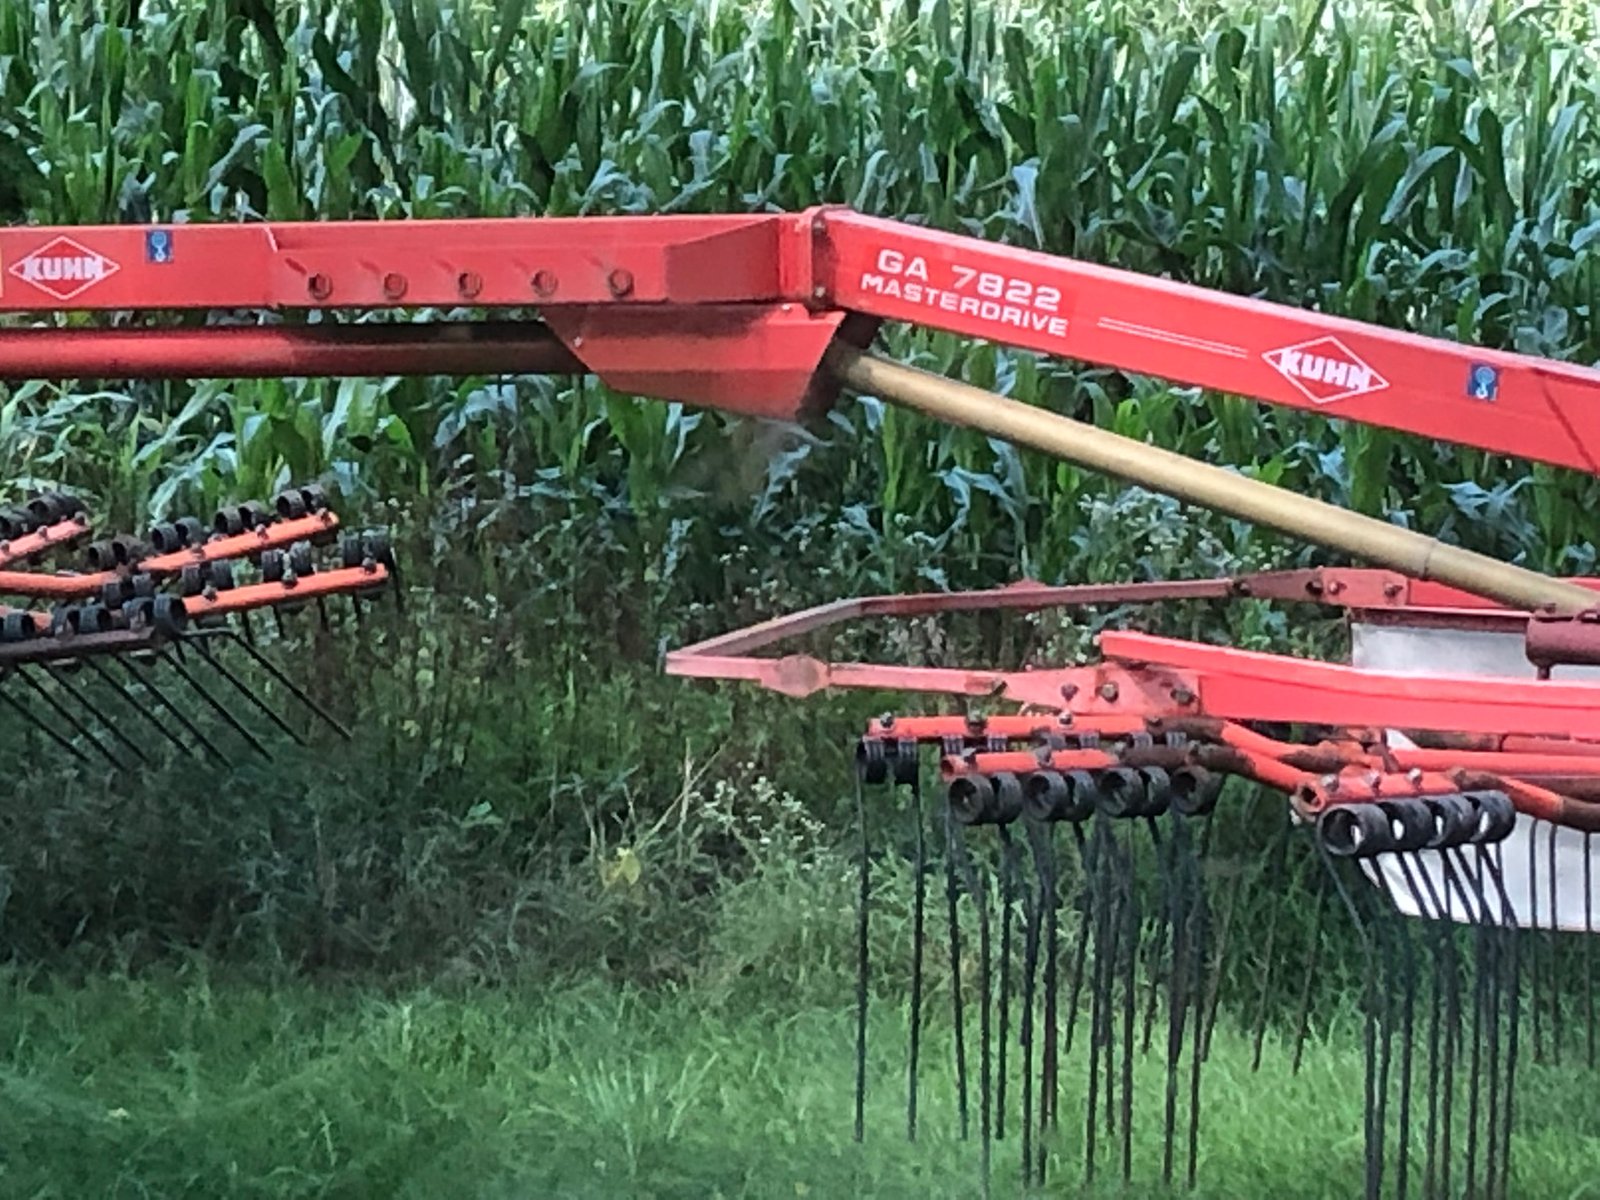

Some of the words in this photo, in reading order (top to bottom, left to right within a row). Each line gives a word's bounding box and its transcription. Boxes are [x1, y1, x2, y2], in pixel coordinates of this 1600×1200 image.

[22, 255, 104, 281] KUHN
[877, 249, 929, 281] GA
[951, 264, 1062, 312] 7822
[861, 273, 1069, 337] MASTERDRIVE
[1278, 348, 1371, 392] KUHN
